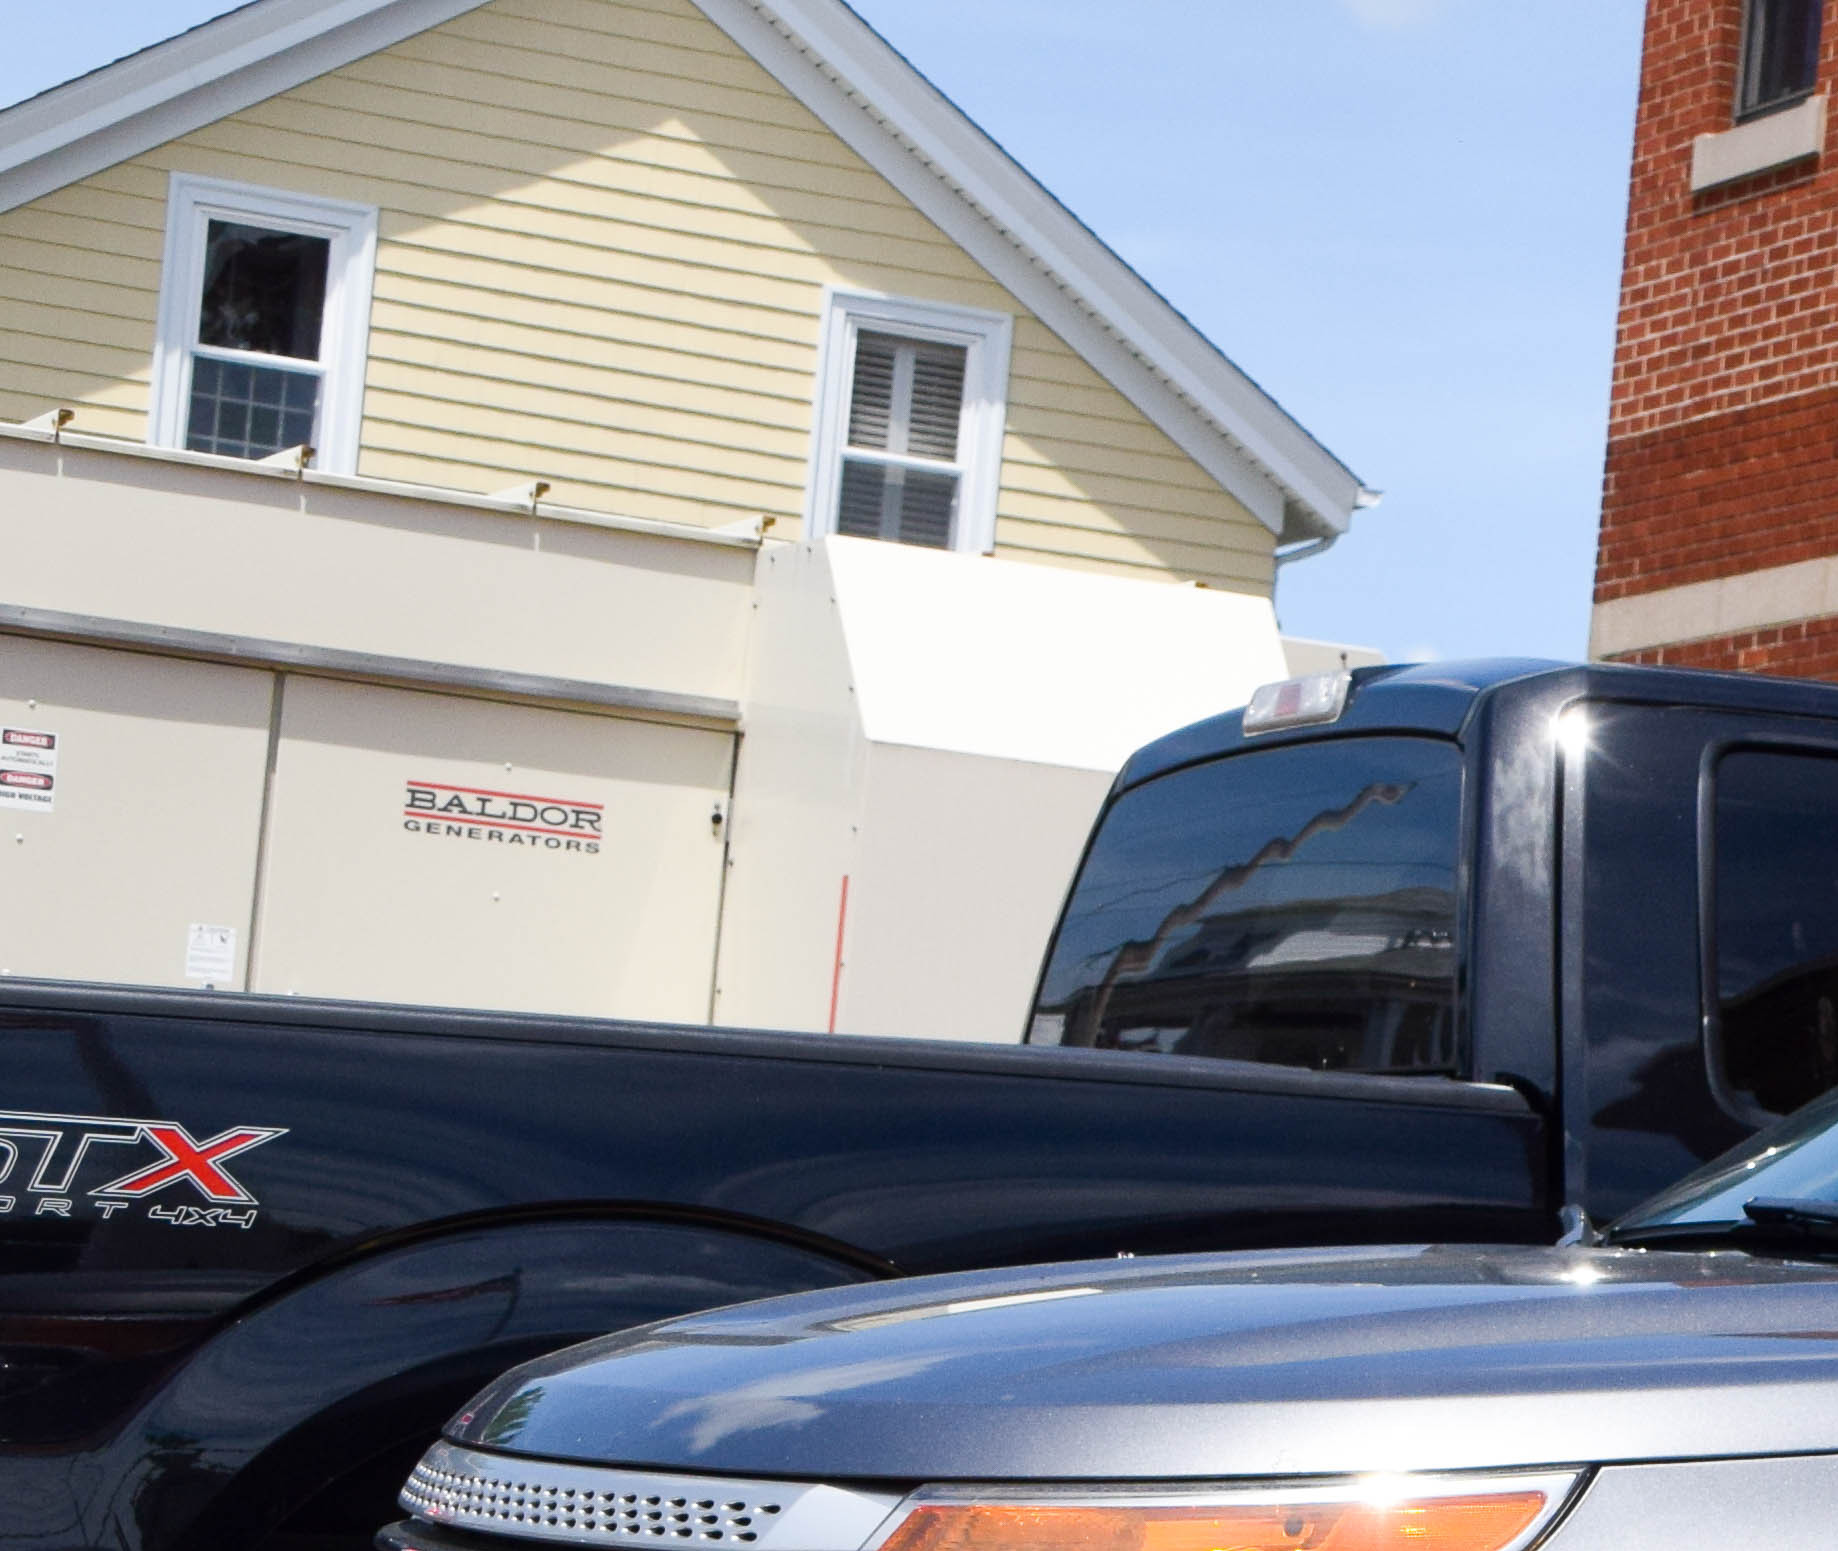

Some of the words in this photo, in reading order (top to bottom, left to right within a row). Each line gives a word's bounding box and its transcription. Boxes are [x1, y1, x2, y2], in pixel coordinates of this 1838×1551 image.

[9, 733, 49, 747] DANGER
[6, 773, 45, 786] DANGER
[404, 788, 603, 832] BALDOR
[403, 819, 601, 854] GENERATORS
